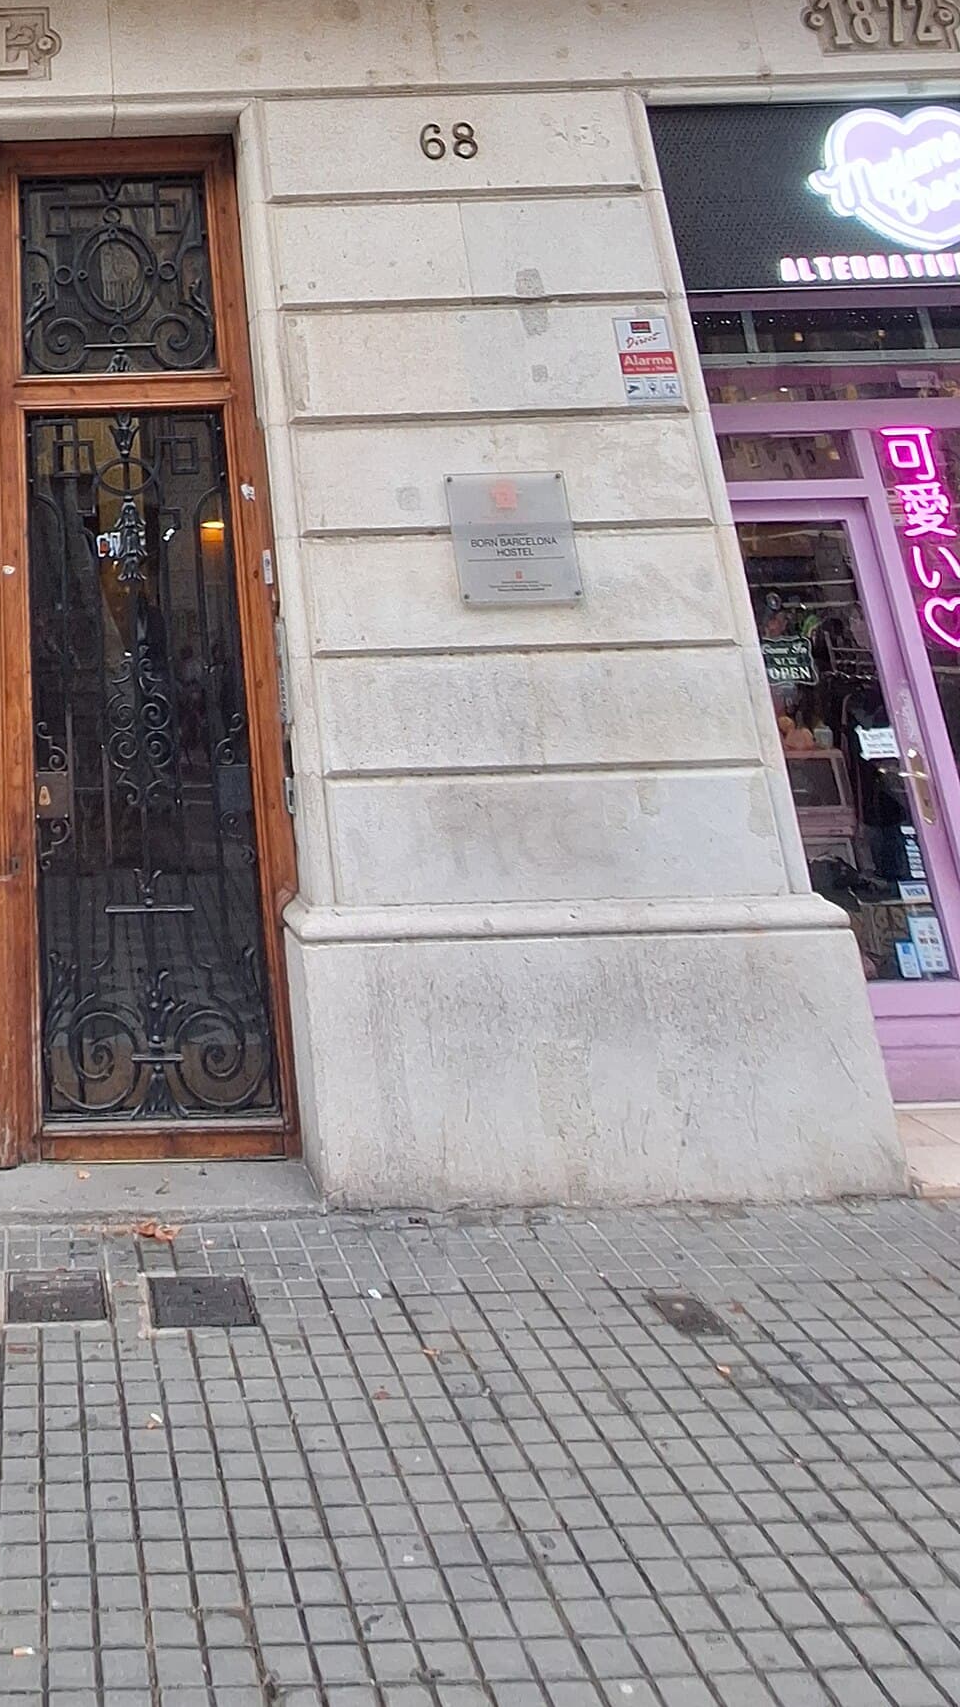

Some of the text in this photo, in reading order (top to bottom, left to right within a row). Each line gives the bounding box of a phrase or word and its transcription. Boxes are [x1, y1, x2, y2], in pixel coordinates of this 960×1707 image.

[419, 123, 478, 160] 68
[624, 355, 673, 366] Alarma
[471, 536, 558, 548] BORN BARCELONA
[496, 548, 535, 557] HOSTEL
[768, 666, 811, 680] OPEN
